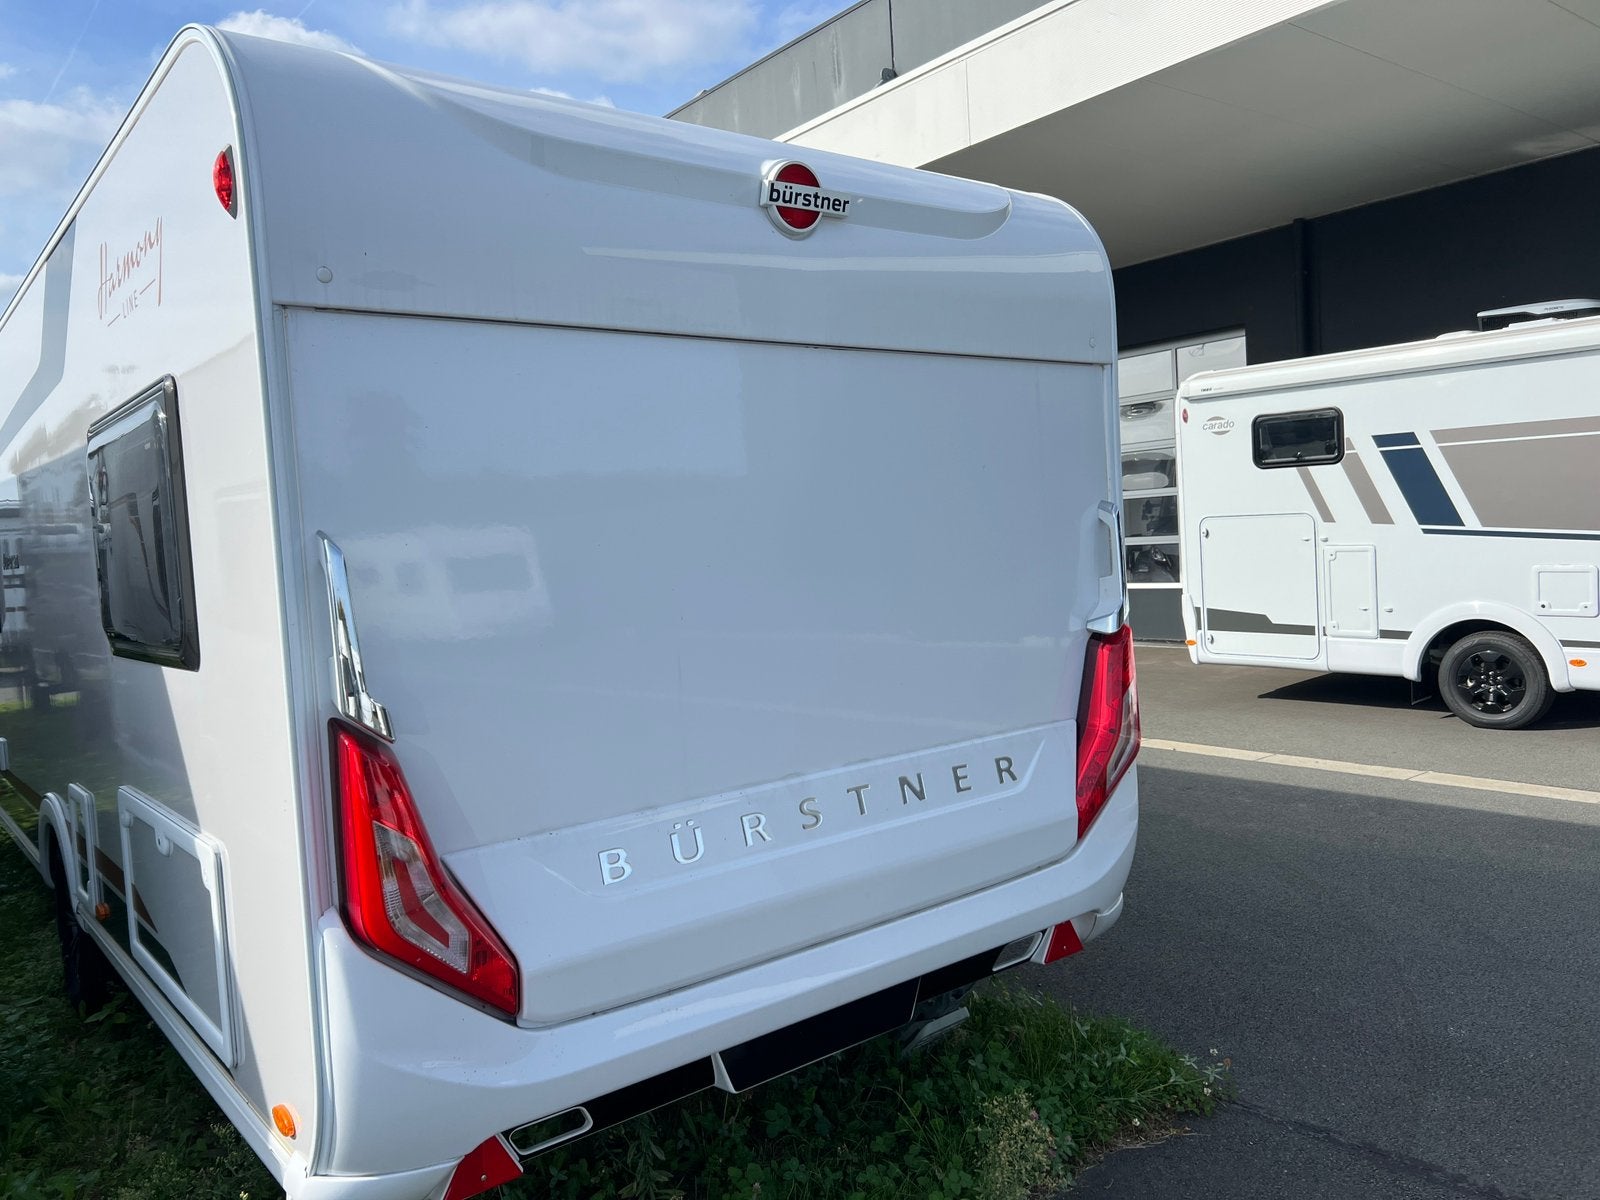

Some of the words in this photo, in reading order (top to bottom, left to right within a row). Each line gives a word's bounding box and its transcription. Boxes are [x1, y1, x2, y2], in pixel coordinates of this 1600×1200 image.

[769, 182, 850, 213] bürstner
[98, 215, 162, 320] Harmony
[122, 289, 138, 319] LINE
[1202, 419, 1235, 431] carado
[597, 756, 1019, 886] BÜRSTNER
